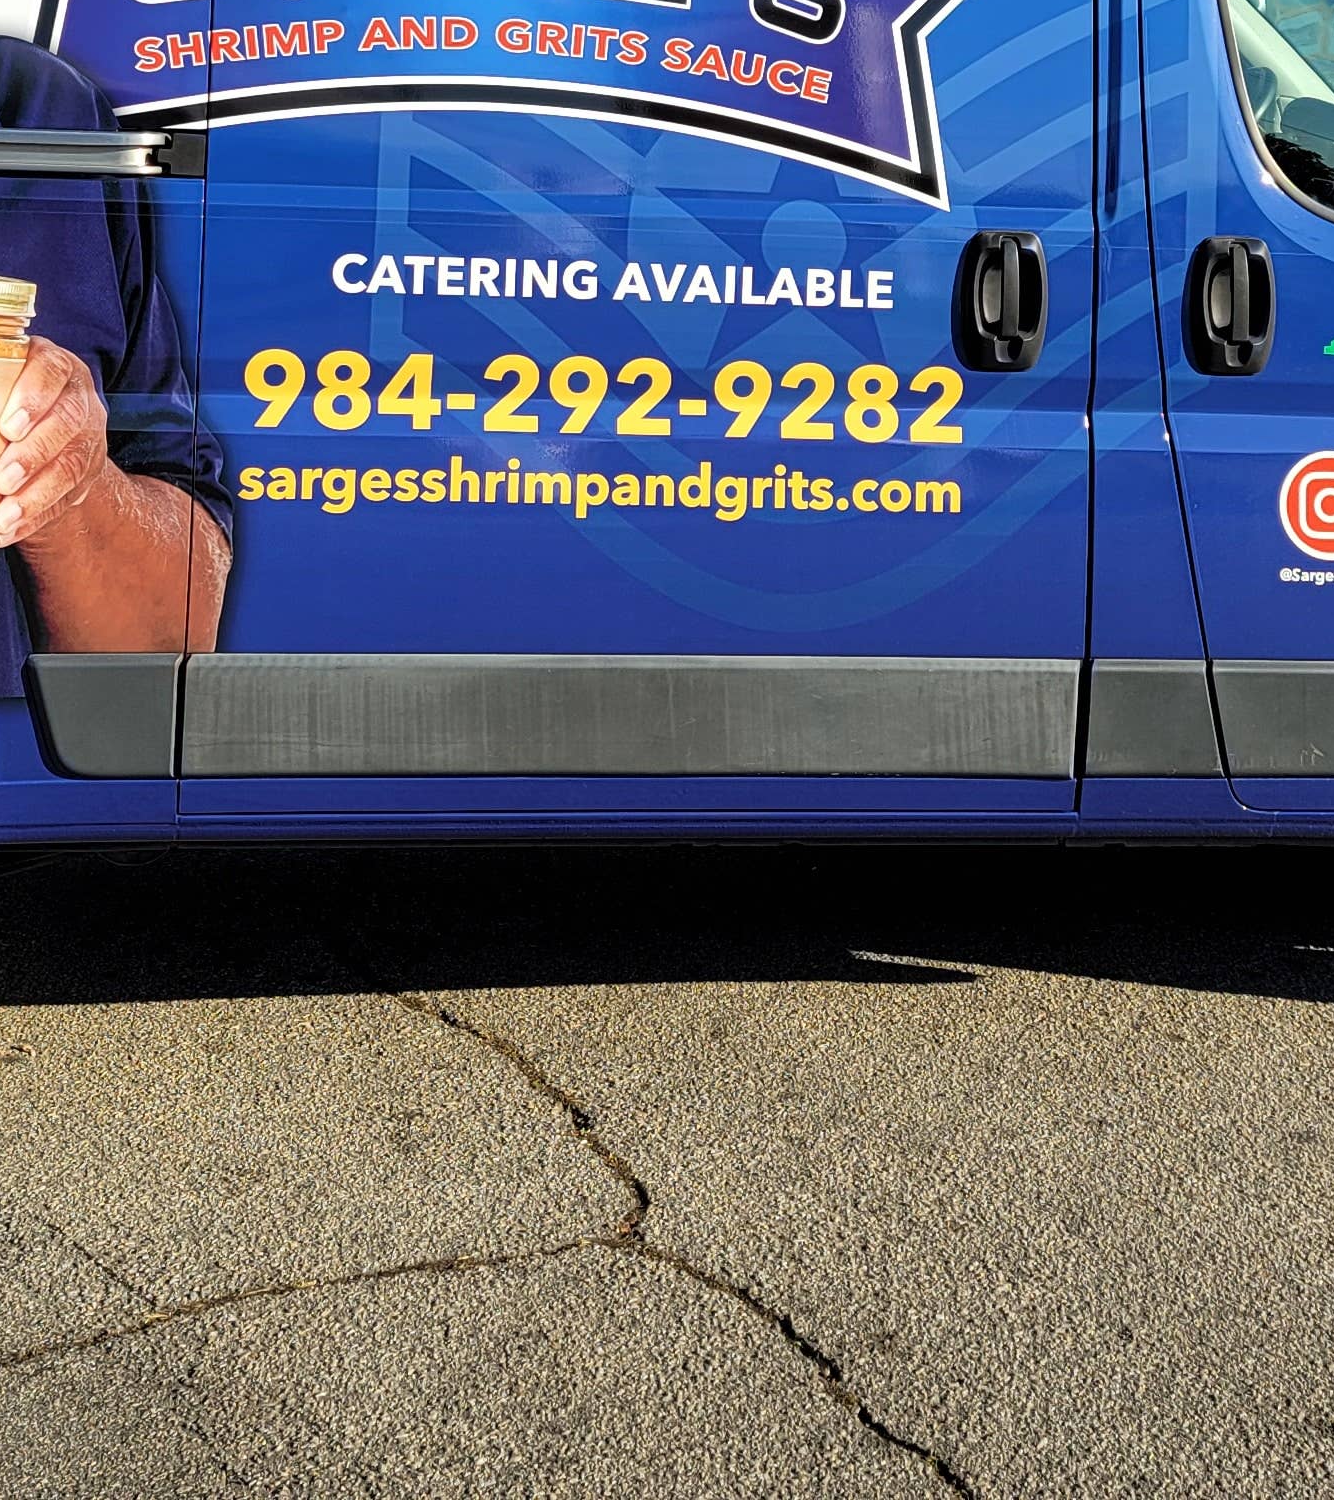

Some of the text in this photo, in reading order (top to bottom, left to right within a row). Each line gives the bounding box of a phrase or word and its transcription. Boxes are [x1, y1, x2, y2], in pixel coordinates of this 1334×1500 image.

[134, 16, 833, 105] SHRIMP AND GRITS SAUCE
[331, 253, 894, 310] CATERING AVAILABLE
[242, 348, 964, 445] 984-292-9282
[238, 456, 962, 522] sargesshrimpandgrits.com
